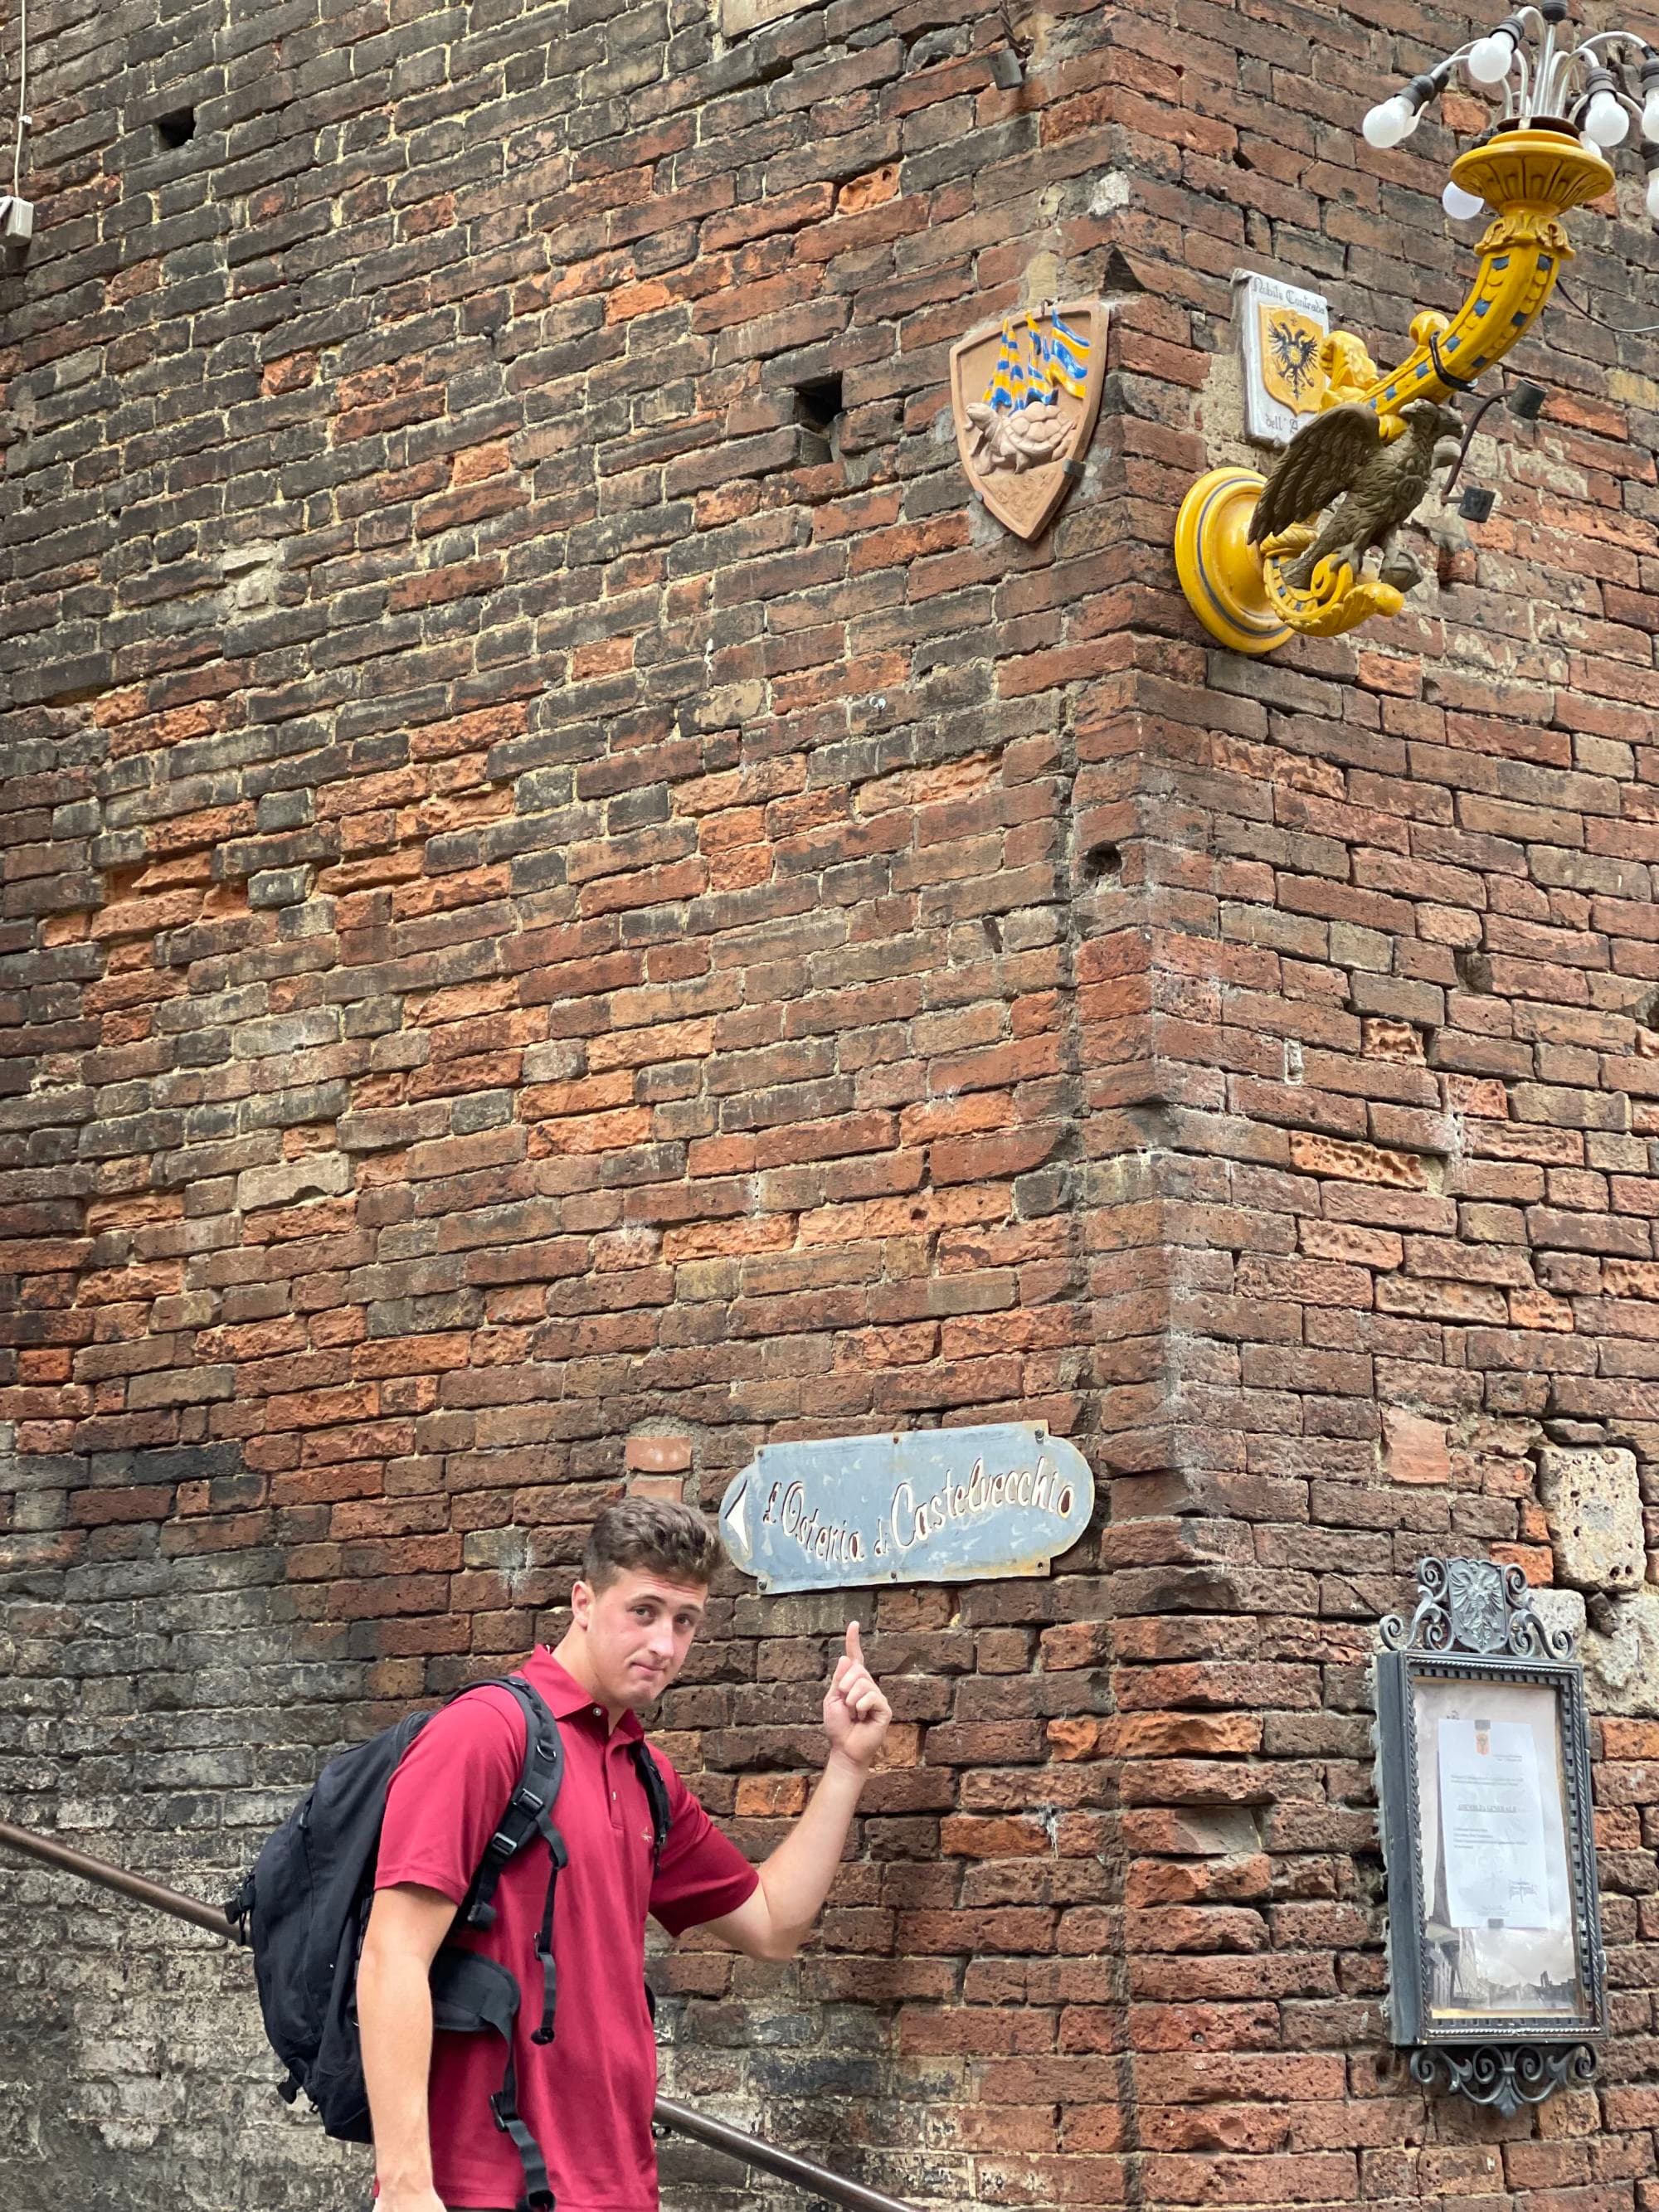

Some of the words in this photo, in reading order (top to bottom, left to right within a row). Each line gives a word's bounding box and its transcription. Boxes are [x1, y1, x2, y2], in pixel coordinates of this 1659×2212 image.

[1253, 277, 1284, 300] Nobile
[1286, 289, 1325, 314] Contrada
[873, 1519, 890, 1557] di
[891, 1456, 1074, 1549] Castelvecchio
